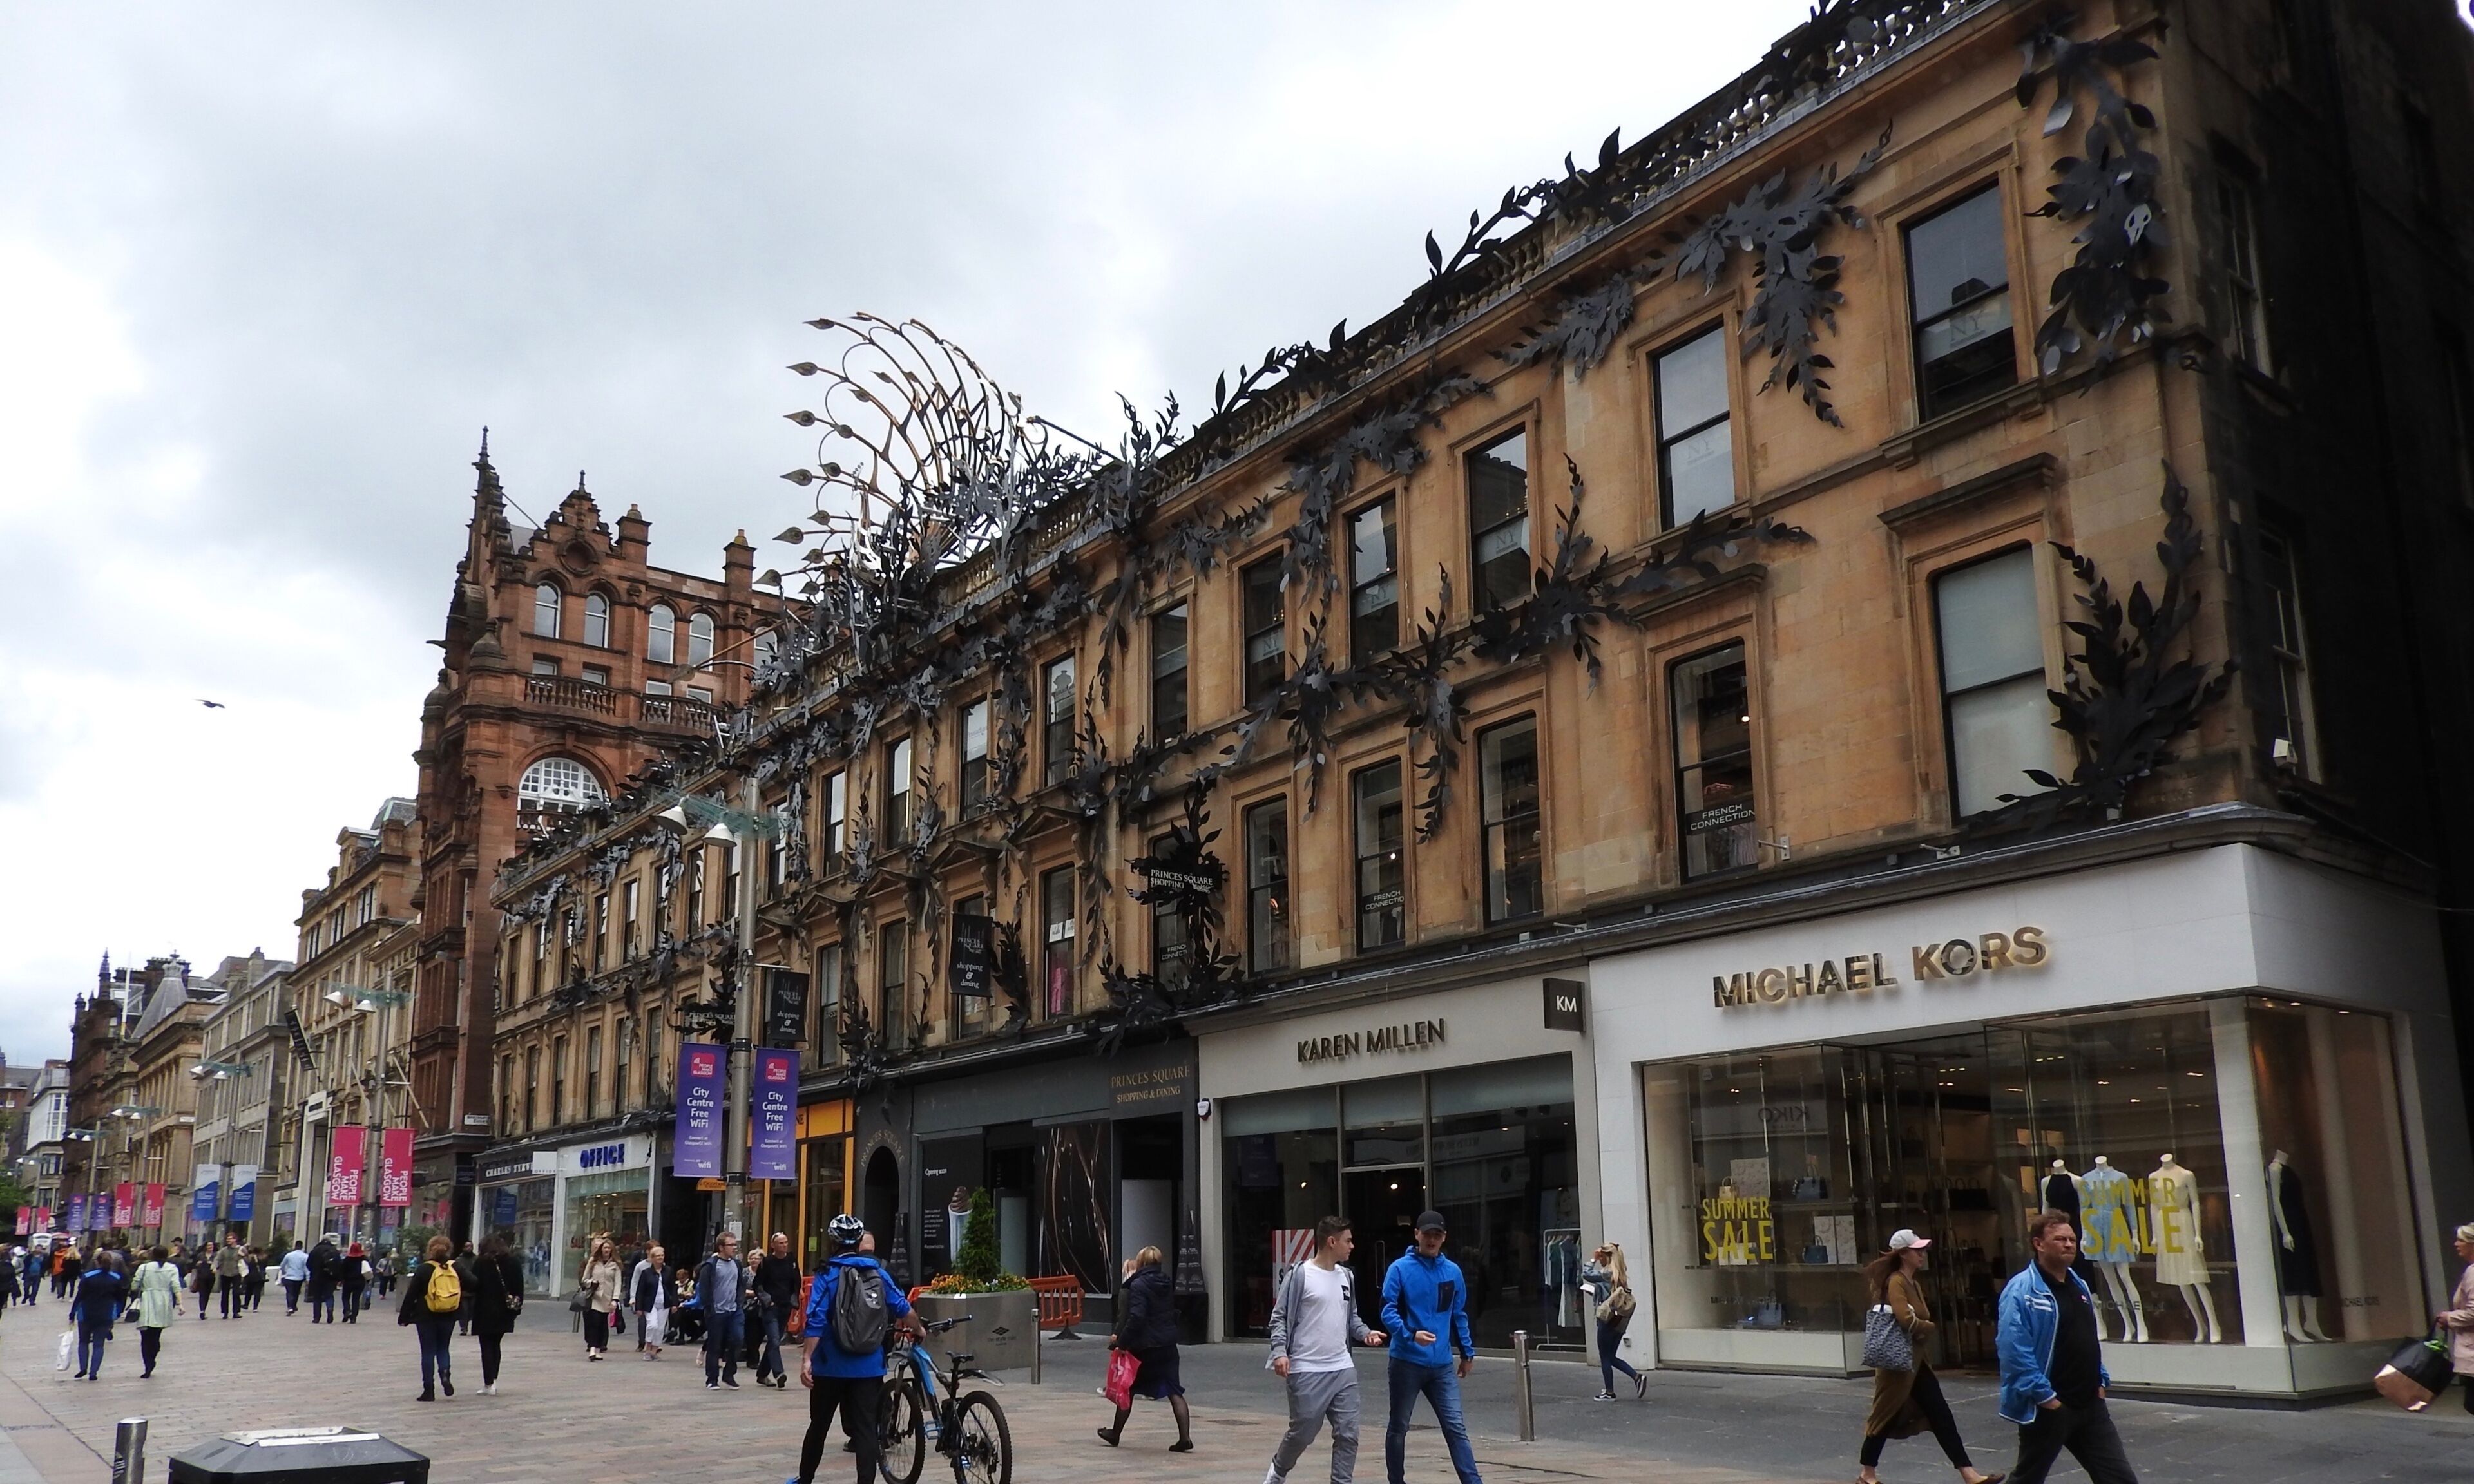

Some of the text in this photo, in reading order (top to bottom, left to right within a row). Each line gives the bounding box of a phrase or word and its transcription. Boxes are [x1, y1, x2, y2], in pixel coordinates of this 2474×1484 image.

[1702, 804, 1742, 819] FRENCH
[1691, 810, 1756, 830] CONNECTION
[1151, 869, 1213, 886] PRINCES SQUARE
[1365, 896, 1405, 910] CONNECTIO
[1373, 890, 1401, 901] FRENCH
[1162, 949, 1187, 960] CONNECTI
[1167, 944, 1186, 953] FRENC
[957, 961, 983, 972] shopping
[1713, 926, 2047, 1007] MICHAEL KORS
[960, 979, 979, 989] dining
[1557, 995, 1577, 1012] KM
[777, 1010, 800, 1020] shopping
[1298, 1018, 1444, 1063] KAREN MILLEN
[1111, 1065, 1191, 1089] PRINCES SQUARE
[693, 1087, 709, 1098] City
[768, 1092, 783, 1102] City
[1117, 1085, 1181, 1103] SHOPPING & DINING
[687, 1098, 714, 1107] Centre
[762, 1102, 788, 1111] Centre
[691, 1108, 709, 1118] Free
[766, 1112, 783, 1121] Free
[690, 1119, 709, 1128] WiFi
[765, 1123, 783, 1131] WiFi
[580, 1143, 624, 1168] OFFICE
[331, 1156, 343, 1201] GLASGOW
[383, 1157, 393, 1201] GLASGOW
[486, 1165, 512, 1177] CHARLES
[925, 1168, 939, 1176] Opening
[339, 1175, 349, 1201] MAKE
[348, 1169, 359, 1201] PEOPLE
[391, 1177, 399, 1201] MAKE
[399, 1170, 408, 1201] PEOPLE
[2079, 1177, 2176, 1206] SUMMER
[1702, 1196, 1770, 1220] SUMMER
[2082, 1206, 2185, 1254] SALE
[1703, 1220, 1774, 1260] SALE
